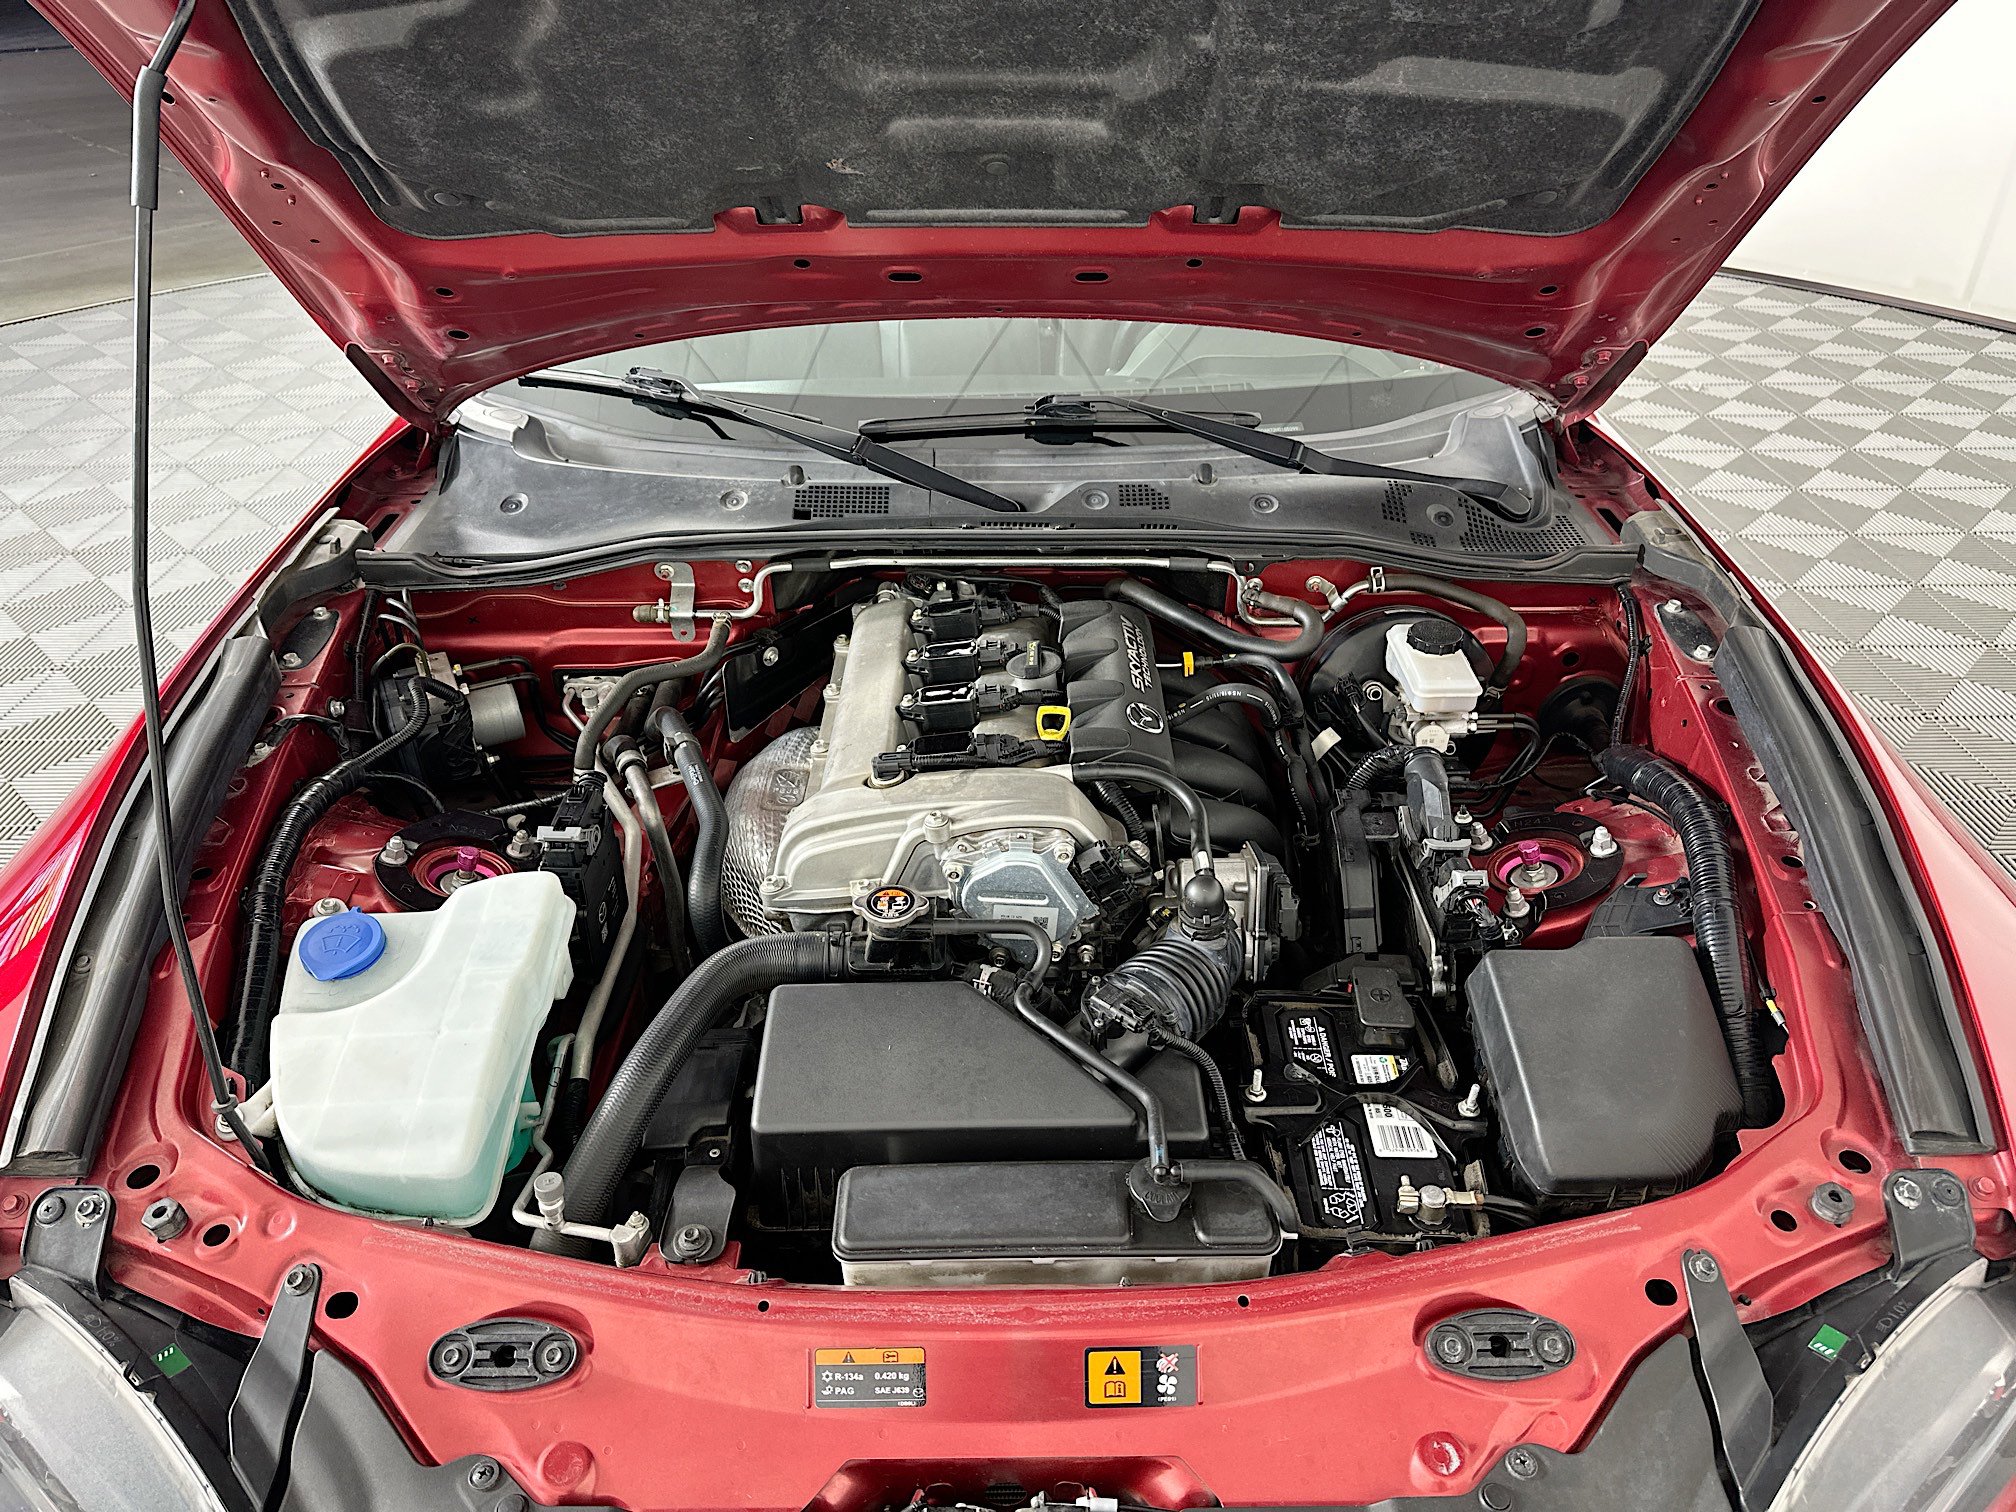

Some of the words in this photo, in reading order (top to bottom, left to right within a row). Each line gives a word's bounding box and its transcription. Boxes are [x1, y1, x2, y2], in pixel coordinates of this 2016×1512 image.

[1120, 614, 1146, 694] SKYACTIV
[1134, 624, 1153, 689] TECHNOLOGY
[1319, 1032, 1332, 1058] DANGER
[834, 1372, 864, 1381] R-134a
[874, 1372, 897, 1380] 0.420
[898, 1372, 910, 1382] kg
[834, 1387, 855, 1395] PAG
